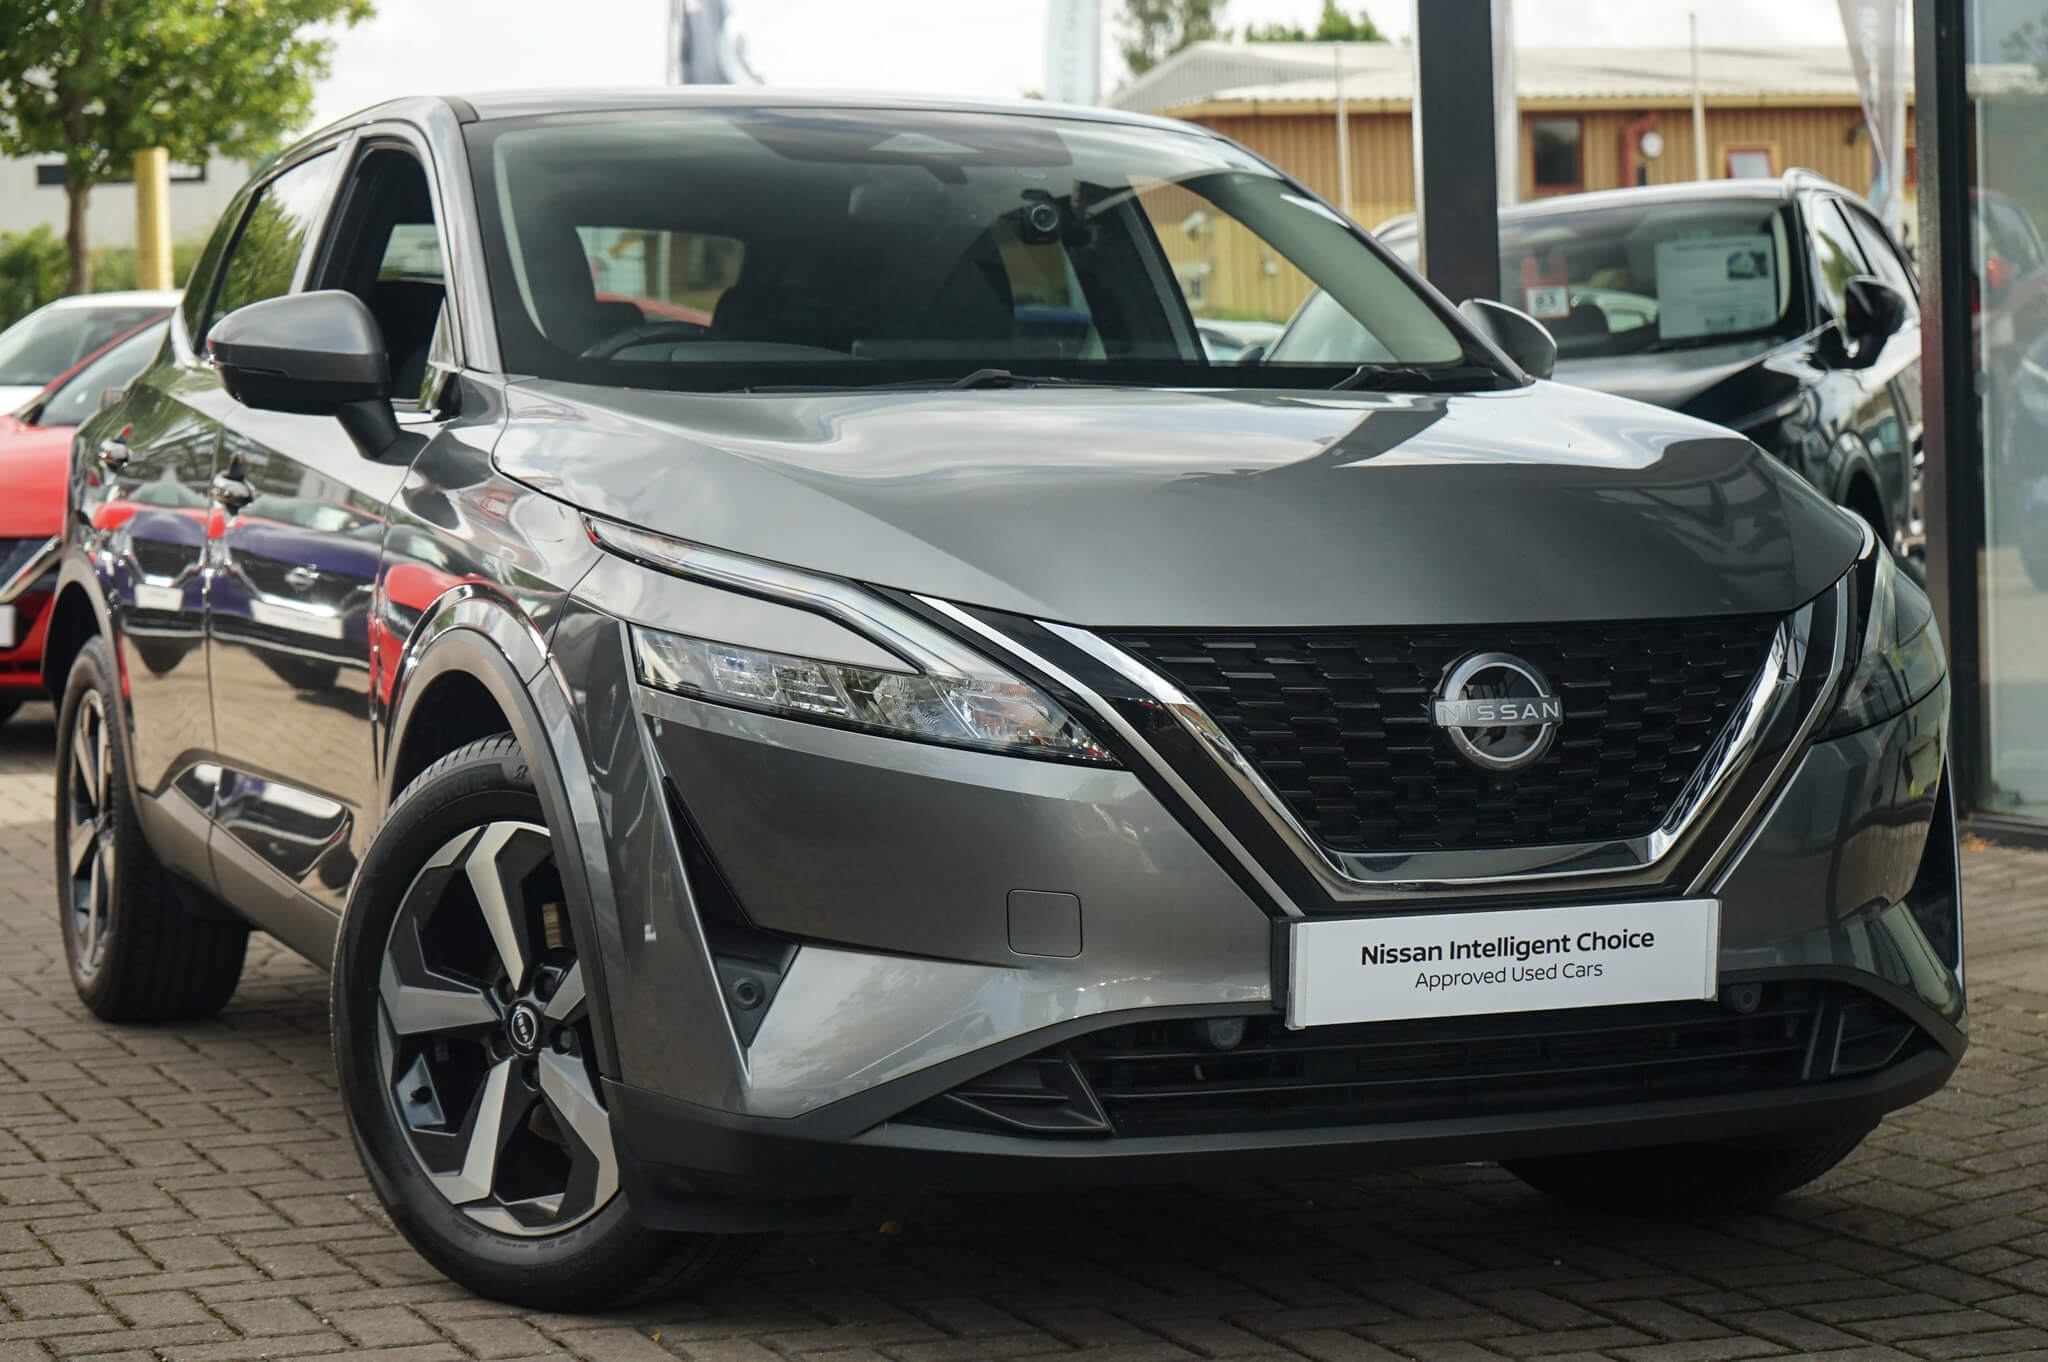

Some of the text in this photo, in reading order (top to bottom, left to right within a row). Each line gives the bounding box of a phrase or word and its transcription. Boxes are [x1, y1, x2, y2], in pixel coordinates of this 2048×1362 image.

[1439, 701, 1560, 721] NISSAN
[1361, 928, 1655, 966] Nissan Intelligent Choice
[1414, 962, 1603, 992] Approved Used Cars
